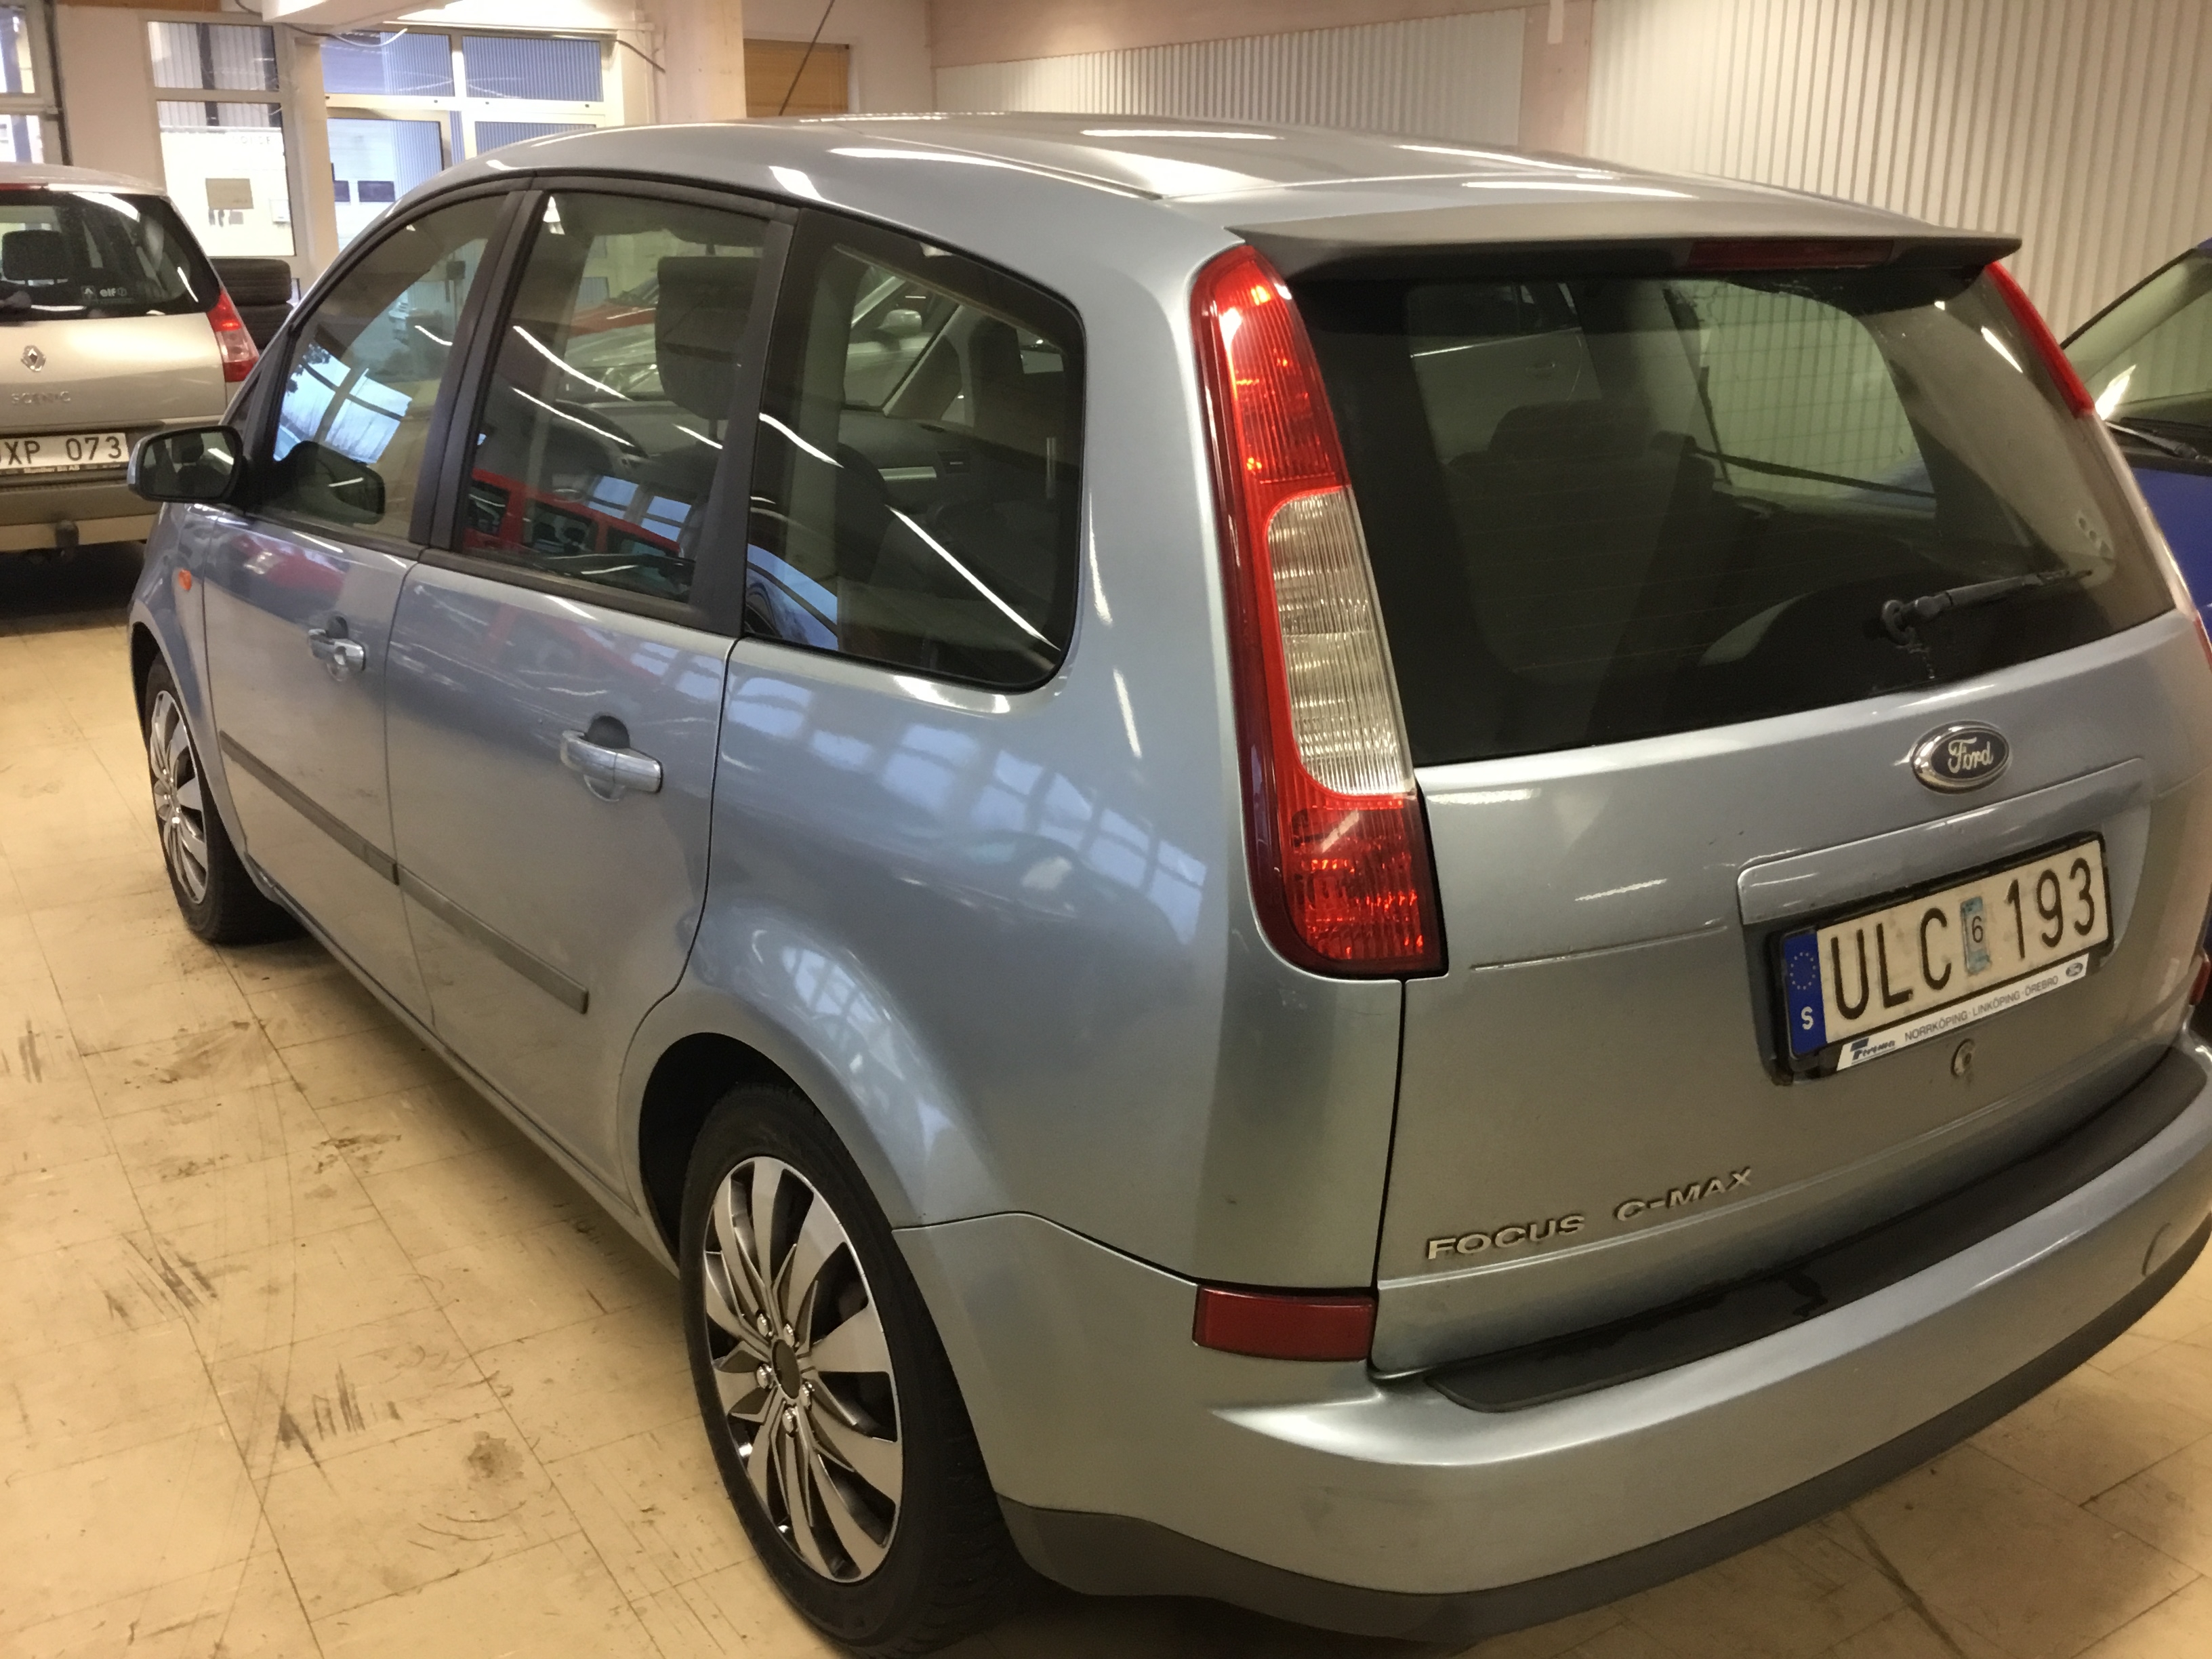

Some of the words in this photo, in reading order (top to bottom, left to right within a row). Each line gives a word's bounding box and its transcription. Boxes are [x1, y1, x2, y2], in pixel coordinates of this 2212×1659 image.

[0, 440, 41, 466] XP
[66, 436, 122, 462] 073
[1946, 736, 1994, 774] Ford
[1830, 907, 1952, 1020] ULC
[1971, 915, 1984, 943] 6
[2005, 857, 2095, 959] 193
[1800, 1006, 1814, 1031] S
[1904, 1010, 1968, 1042] NORRKÖPING
[1972, 990, 2021, 1017] LINKÖPING
[2024, 975, 2060, 997] ÖREBRO
[1426, 1214, 1585, 1260] FOCUS
[1613, 1166, 1752, 1222] C-MAX
